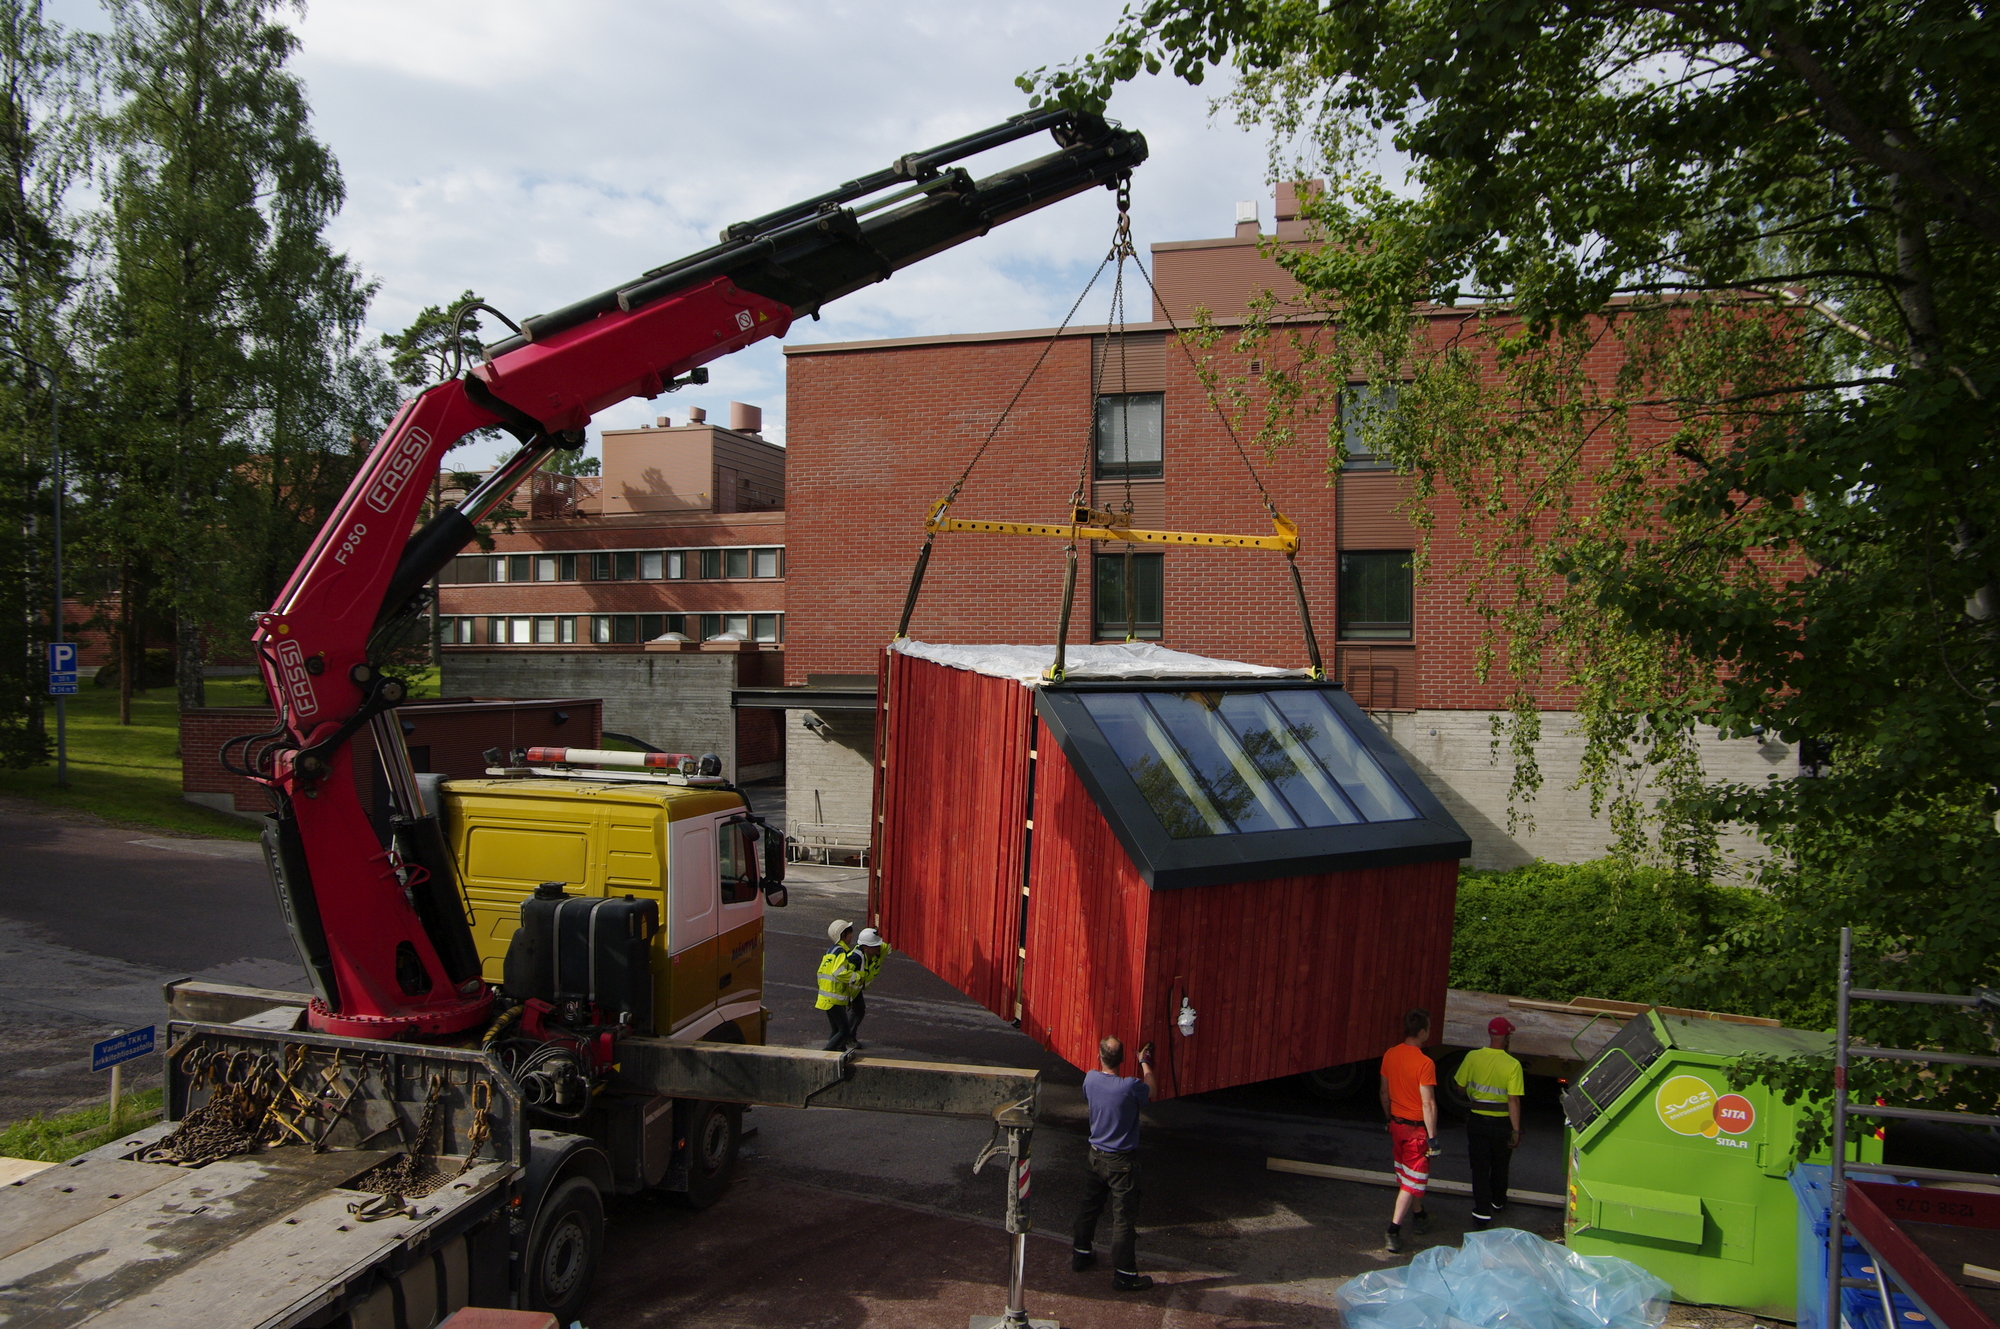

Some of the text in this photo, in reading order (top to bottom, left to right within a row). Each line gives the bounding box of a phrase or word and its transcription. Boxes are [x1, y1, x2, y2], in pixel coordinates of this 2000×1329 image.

[369, 433, 429, 508] FASSI
[334, 523, 367, 566] F950
[55, 645, 73, 671] P
[281, 645, 315, 713] FASSI
[94, 1042, 154, 1067] arkkitehtiosastolle
[102, 1040, 127, 1054] Varattu
[1669, 1101, 1712, 1120] environnement
[1720, 1108, 1747, 1120] SITA
[1716, 1137, 1748, 1149] SITA.FI
